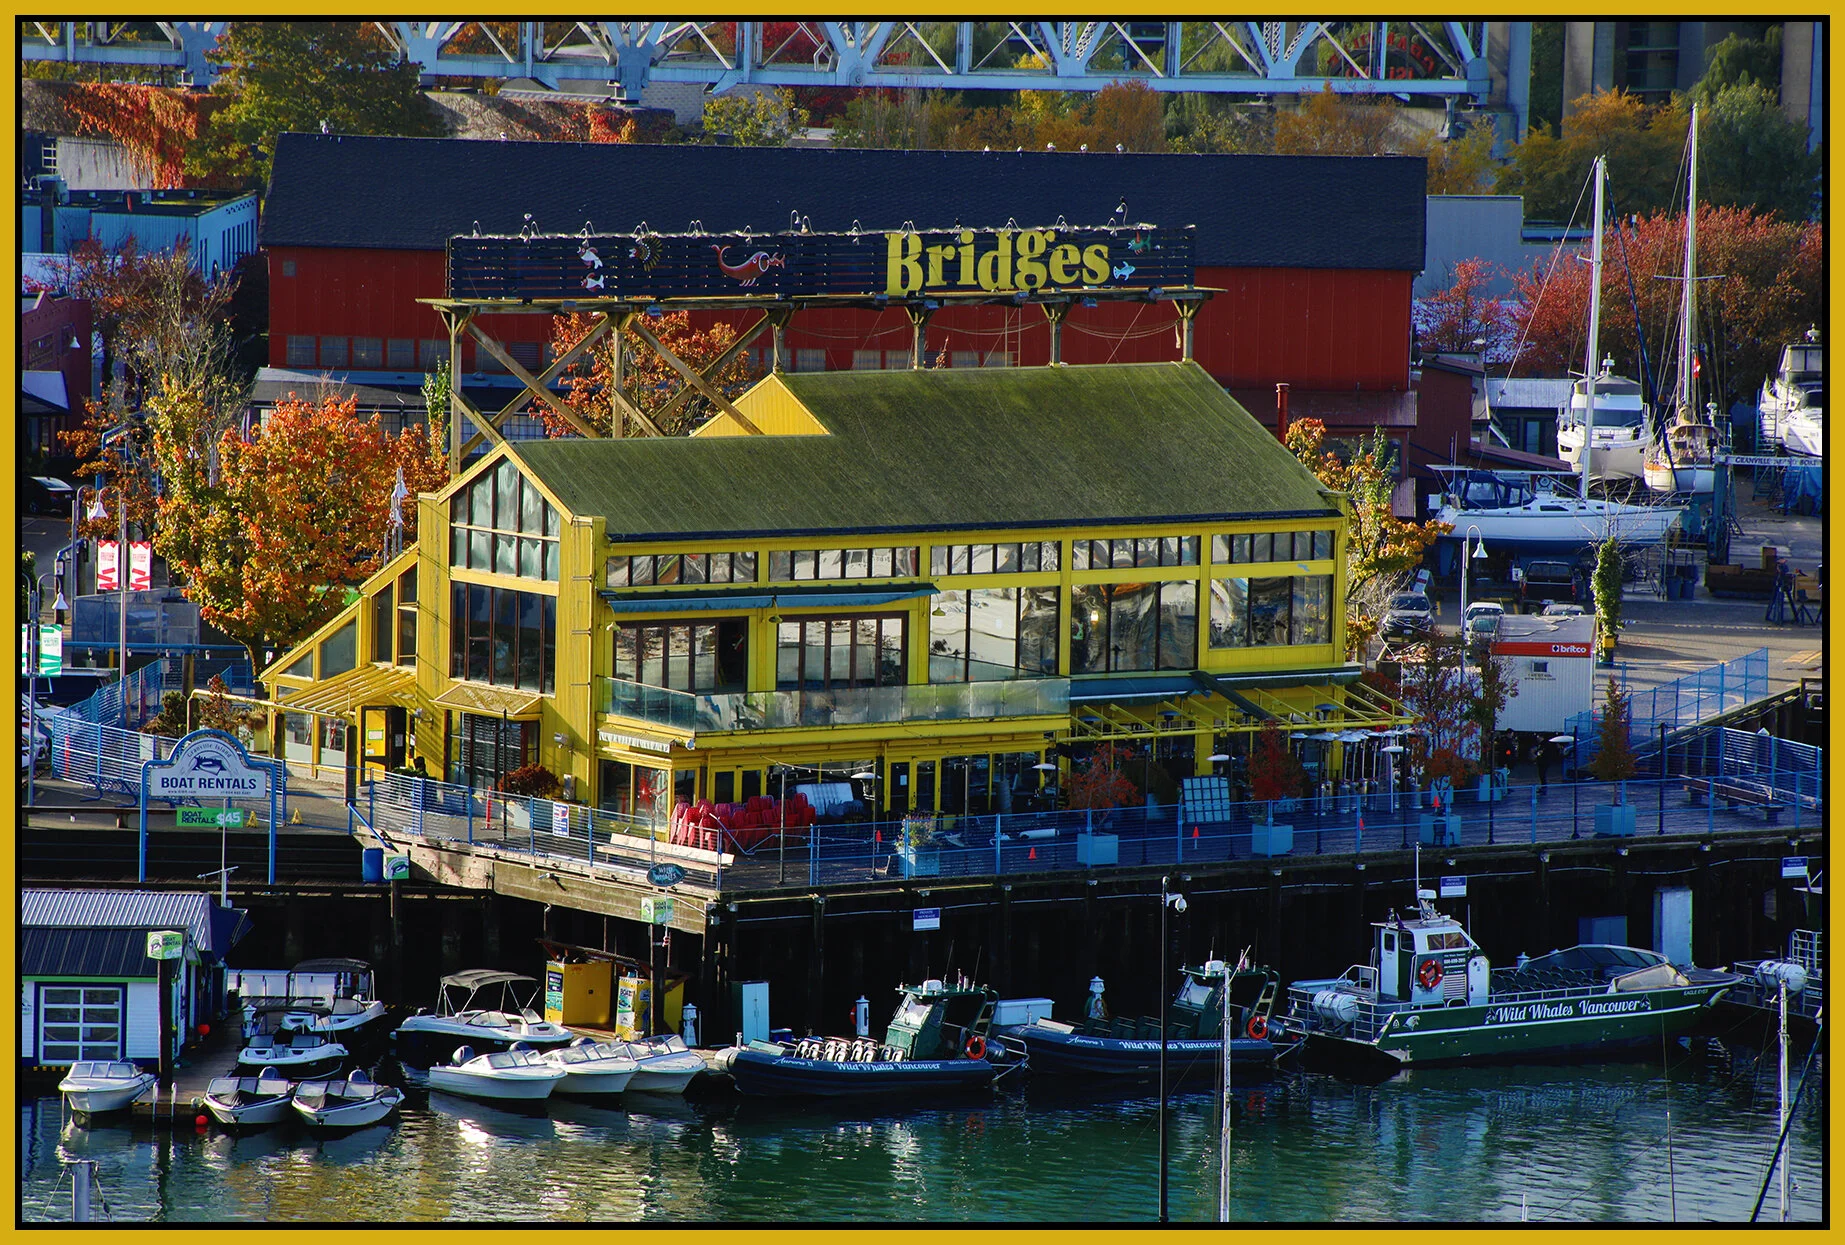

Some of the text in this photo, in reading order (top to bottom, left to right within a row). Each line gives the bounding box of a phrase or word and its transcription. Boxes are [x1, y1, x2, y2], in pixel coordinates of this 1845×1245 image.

[884, 230, 1110, 295] Bridges
[1560, 645, 1586, 653] britco
[161, 777, 257, 790] BOAT RENTALS
[216, 812, 241, 826] $45
[1495, 999, 1641, 1022] Wild Whales Vancouver
[1119, 1041, 1144, 1049] Wild
[1178, 1041, 1222, 1049] Vancouver
[833, 1063, 859, 1071] Wild
[859, 1063, 894, 1072] Whales
[894, 1062, 940, 1070] Vancouver
